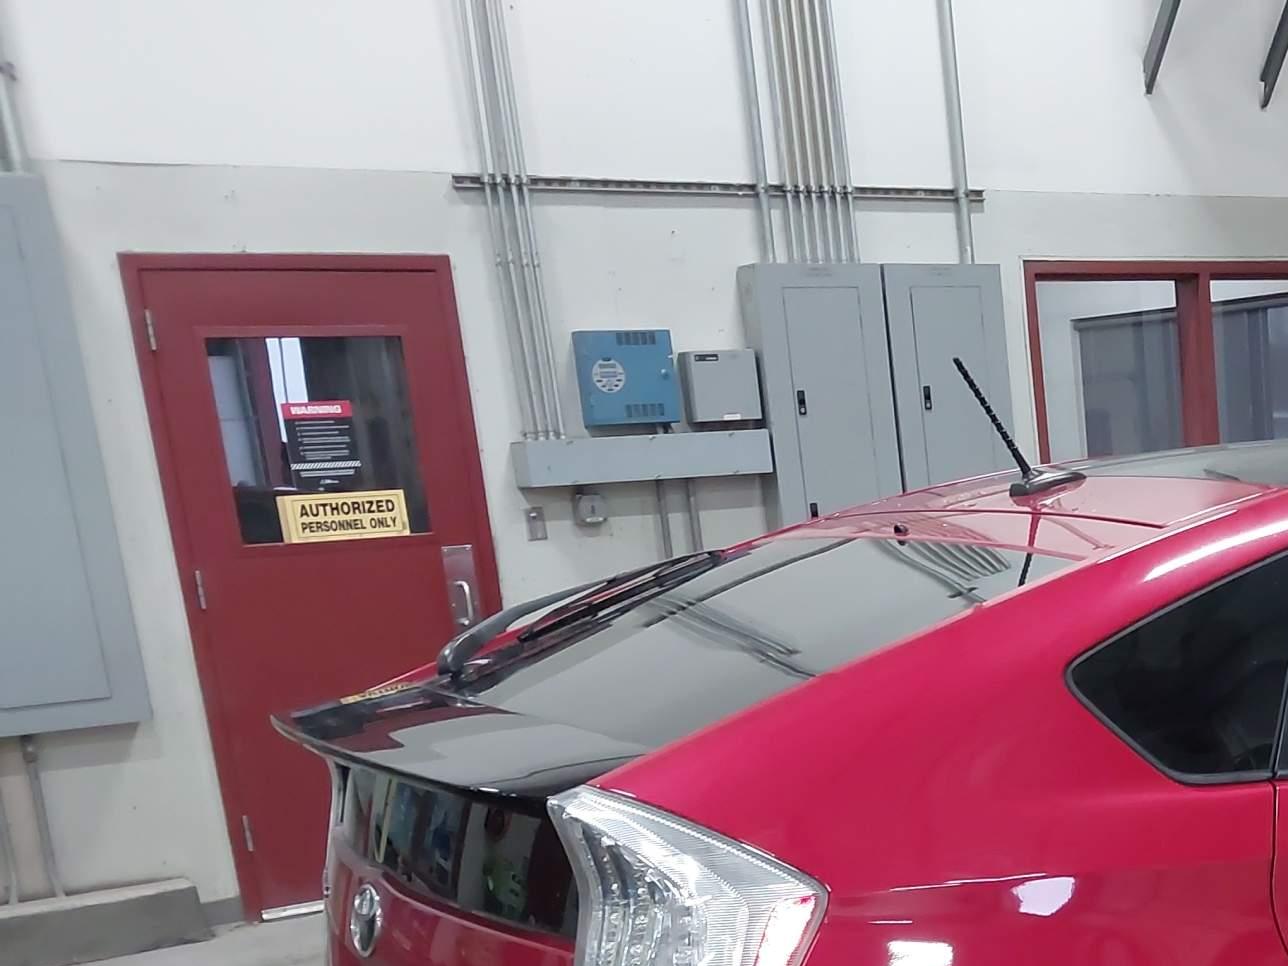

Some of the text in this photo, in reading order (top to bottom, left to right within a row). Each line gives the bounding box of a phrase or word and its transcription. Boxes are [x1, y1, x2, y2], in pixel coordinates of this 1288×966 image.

[290, 405, 342, 415] WARNING
[300, 499, 395, 518] AUTHORIZED
[301, 517, 397, 534] PERSONNEL ONLY
